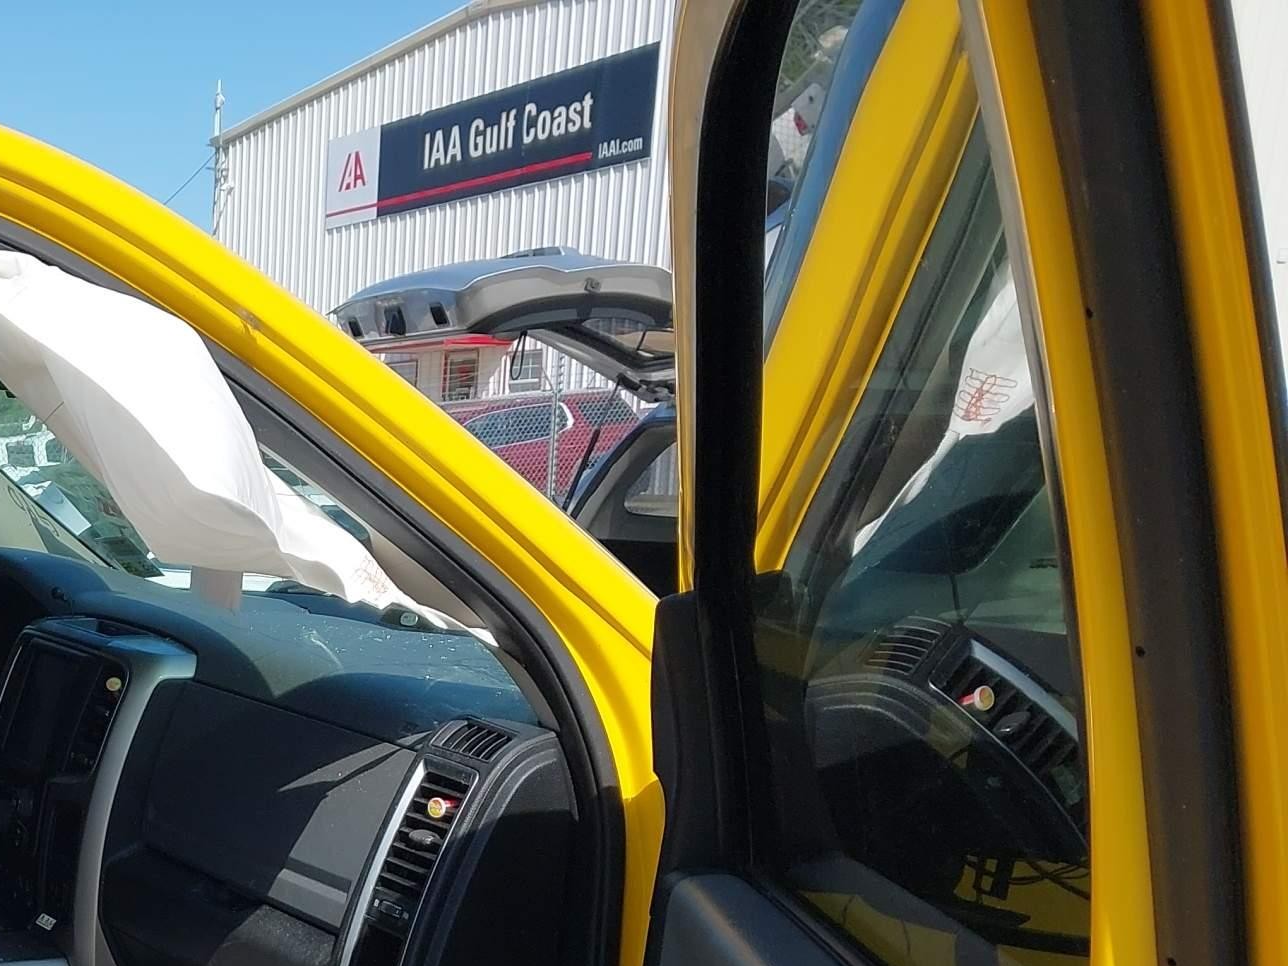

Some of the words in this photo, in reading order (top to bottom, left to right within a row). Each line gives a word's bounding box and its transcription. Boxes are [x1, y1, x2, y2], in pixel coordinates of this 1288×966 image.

[423, 125, 462, 169] IAA
[468, 108, 517, 158] Gulf
[522, 91, 594, 144] Coast
[598, 137, 644, 159] IAAI.com
